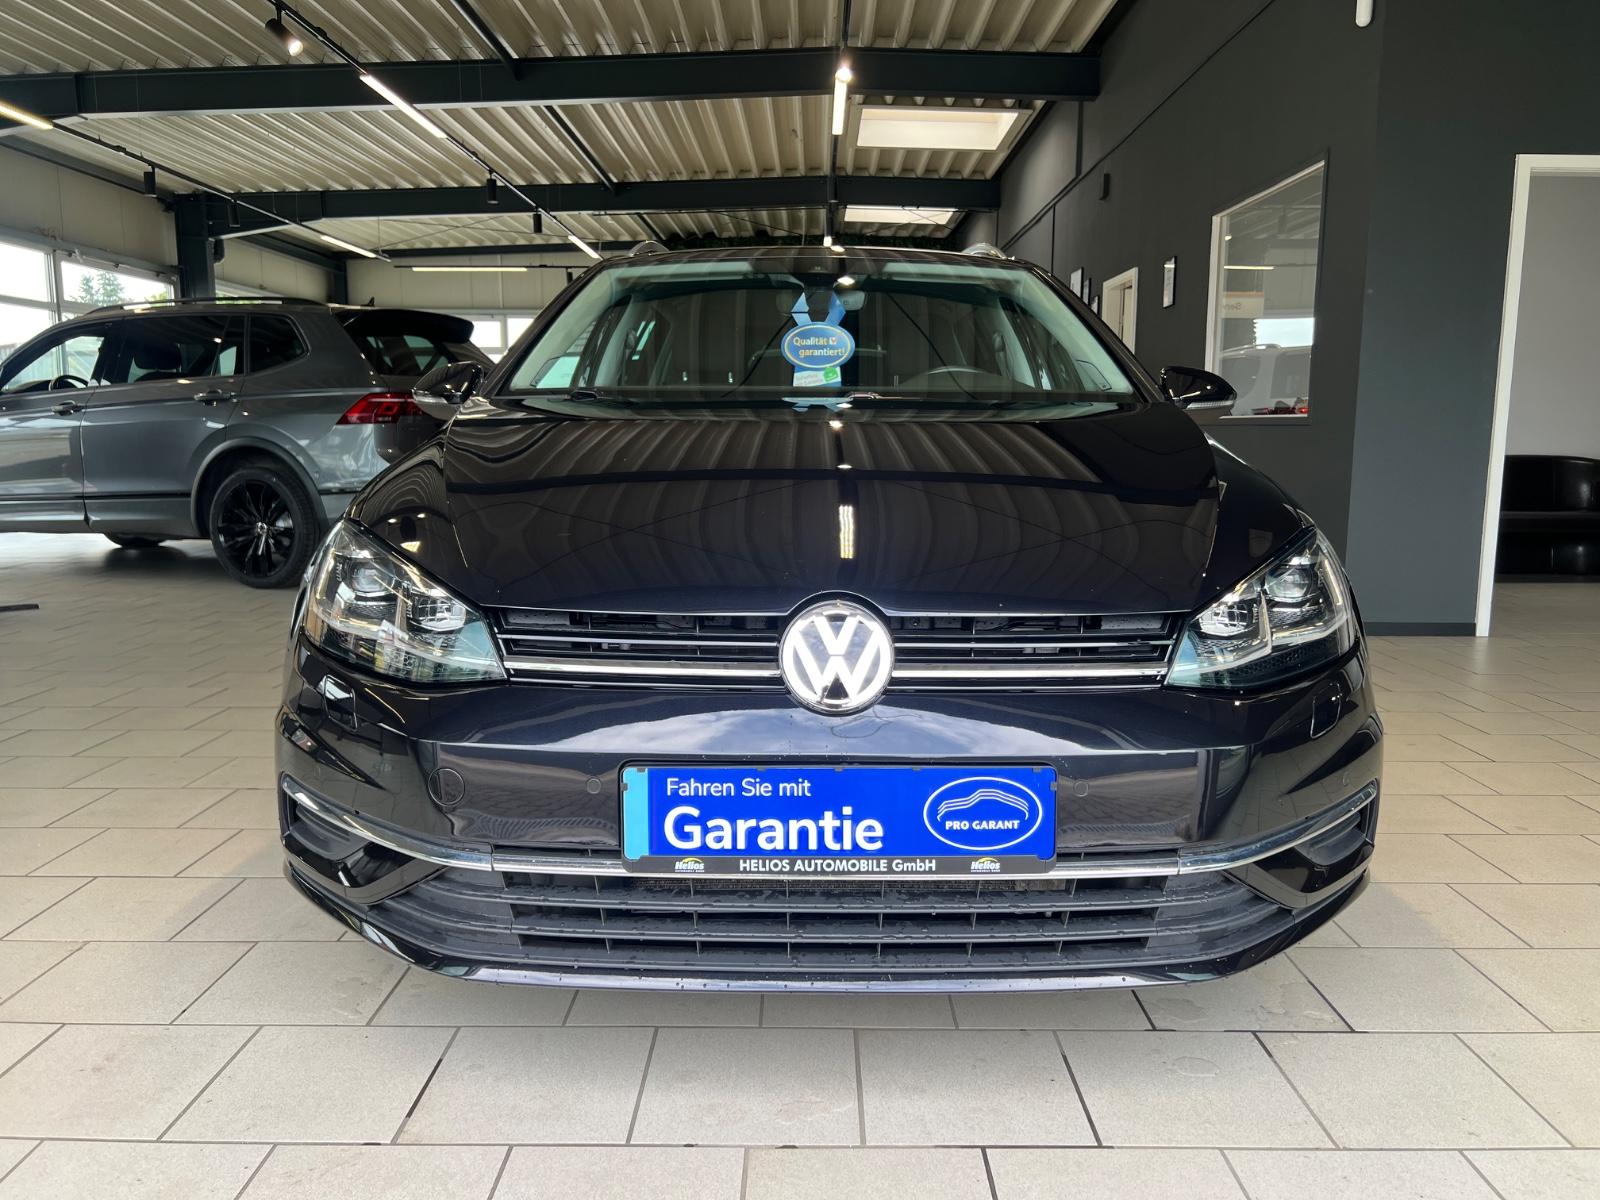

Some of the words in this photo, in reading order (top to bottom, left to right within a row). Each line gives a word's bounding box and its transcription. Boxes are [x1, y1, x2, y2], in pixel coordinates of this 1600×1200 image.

[794, 336, 828, 346] Qualität
[798, 347, 845, 358] garantiert!
[784, 606, 890, 708] VW
[666, 777, 735, 797] Fahren
[741, 777, 772, 797] Sie
[779, 777, 812, 797] mit
[663, 805, 884, 850] Garantie
[945, 820, 970, 830] PRO
[971, 820, 1020, 830] GARANT
[674, 861, 705, 870] Helios
[739, 858, 790, 872] HELIOS
[793, 858, 888, 872] AUTOMOBILE
[892, 858, 936, 872] GmbH
[970, 861, 1000, 870] Helios
